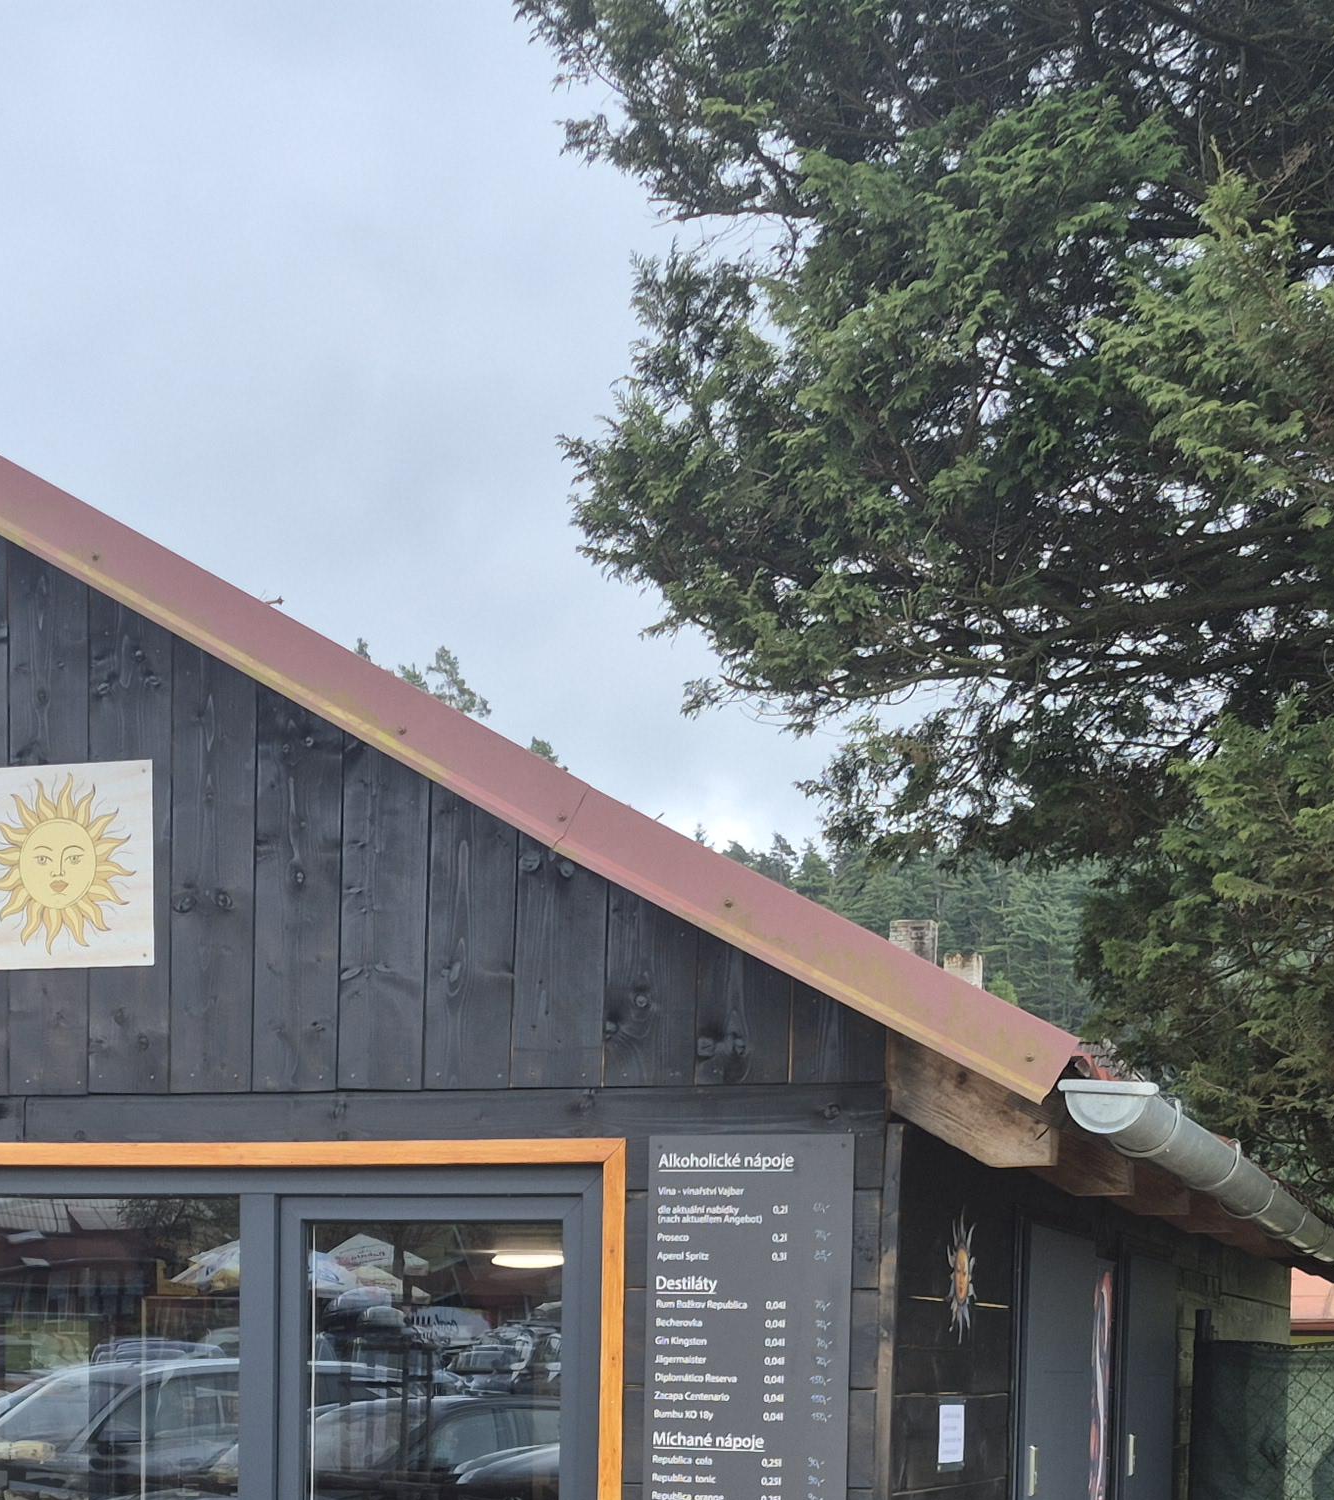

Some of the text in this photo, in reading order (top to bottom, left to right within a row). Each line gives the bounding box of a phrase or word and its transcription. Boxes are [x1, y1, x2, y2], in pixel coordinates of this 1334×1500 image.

[659, 1153, 794, 1170] Alkoholické nápoje
[656, 1275, 717, 1292] Destiláty
[653, 1431, 764, 1449] Míchané nápoje
